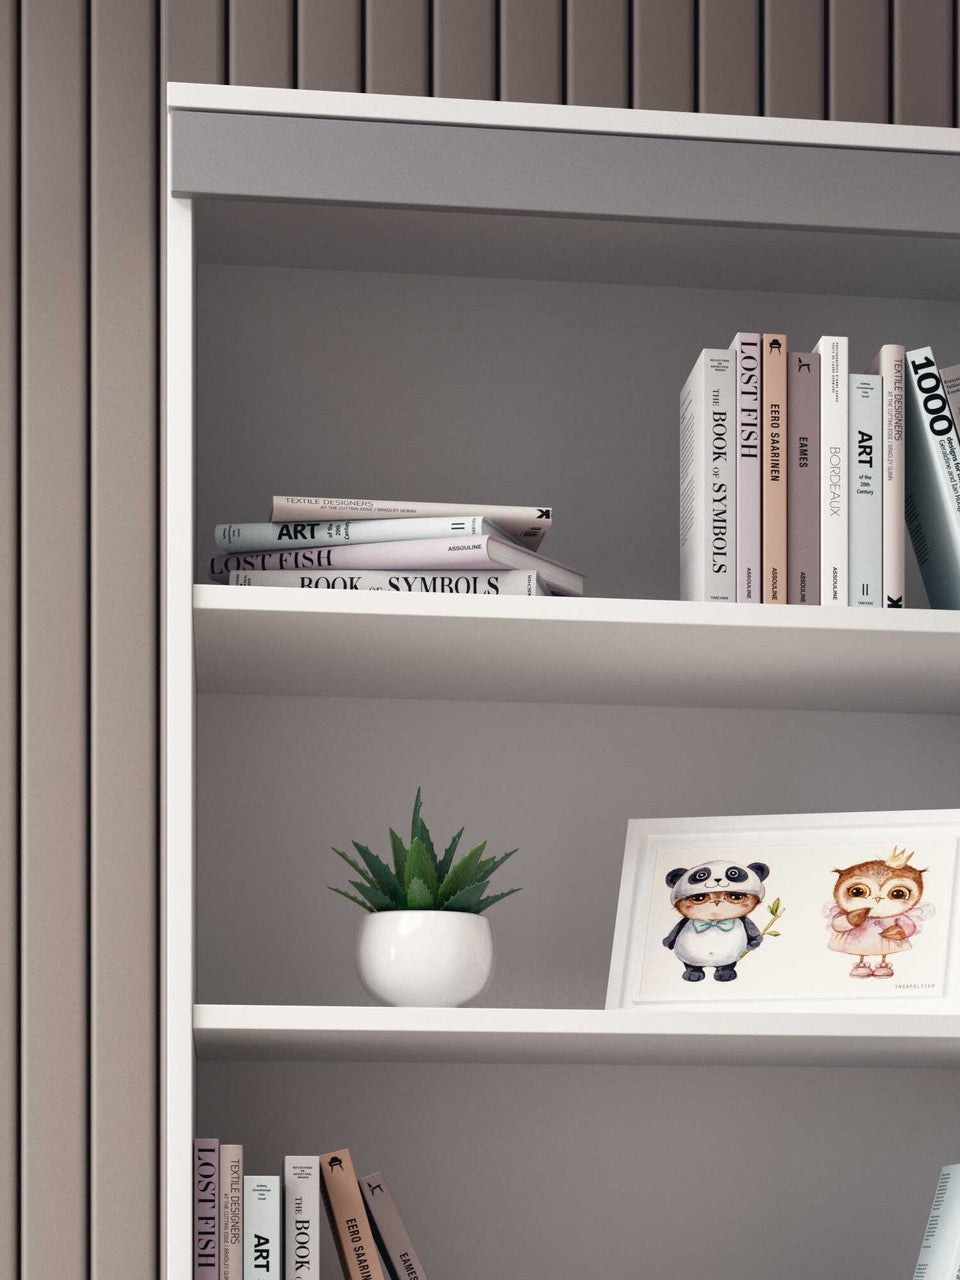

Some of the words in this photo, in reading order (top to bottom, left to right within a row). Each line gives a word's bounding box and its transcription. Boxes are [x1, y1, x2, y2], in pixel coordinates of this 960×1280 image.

[740, 341, 758, 402] LOST
[894, 359, 903, 392] TEXTILE
[712, 388, 720, 407] THE
[911, 356, 953, 437] 1000
[740, 408, 758, 459] FISH
[770, 404, 780, 429] EERO
[894, 393, 903, 441] DESIGNERS
[712, 411, 727, 462] BOOK
[798, 436, 808, 468] EAMES
[858, 430, 873, 468] ART
[945, 436, 959, 462] designs
[712, 467, 720, 479] OF
[770, 432, 780, 482] SAARINEN
[829, 446, 841, 517] BORDEAUX
[947, 470, 956, 483] and
[277, 523, 320, 540] ART
[712, 483, 727, 574] SYMBOLS
[209, 553, 271, 575] LOST
[278, 549, 332, 570] FISH
[197, 1148, 216, 1209] LOST
[230, 1160, 240, 1193] TEXTILE
[230, 1195, 240, 1245] DESIGNERS
[295, 1196, 303, 1215] THE
[197, 1216, 216, 1268] FISH
[295, 1220, 310, 1271] BOOK
[346, 1218, 361, 1244] EERO
[254, 1234, 270, 1273] ART
